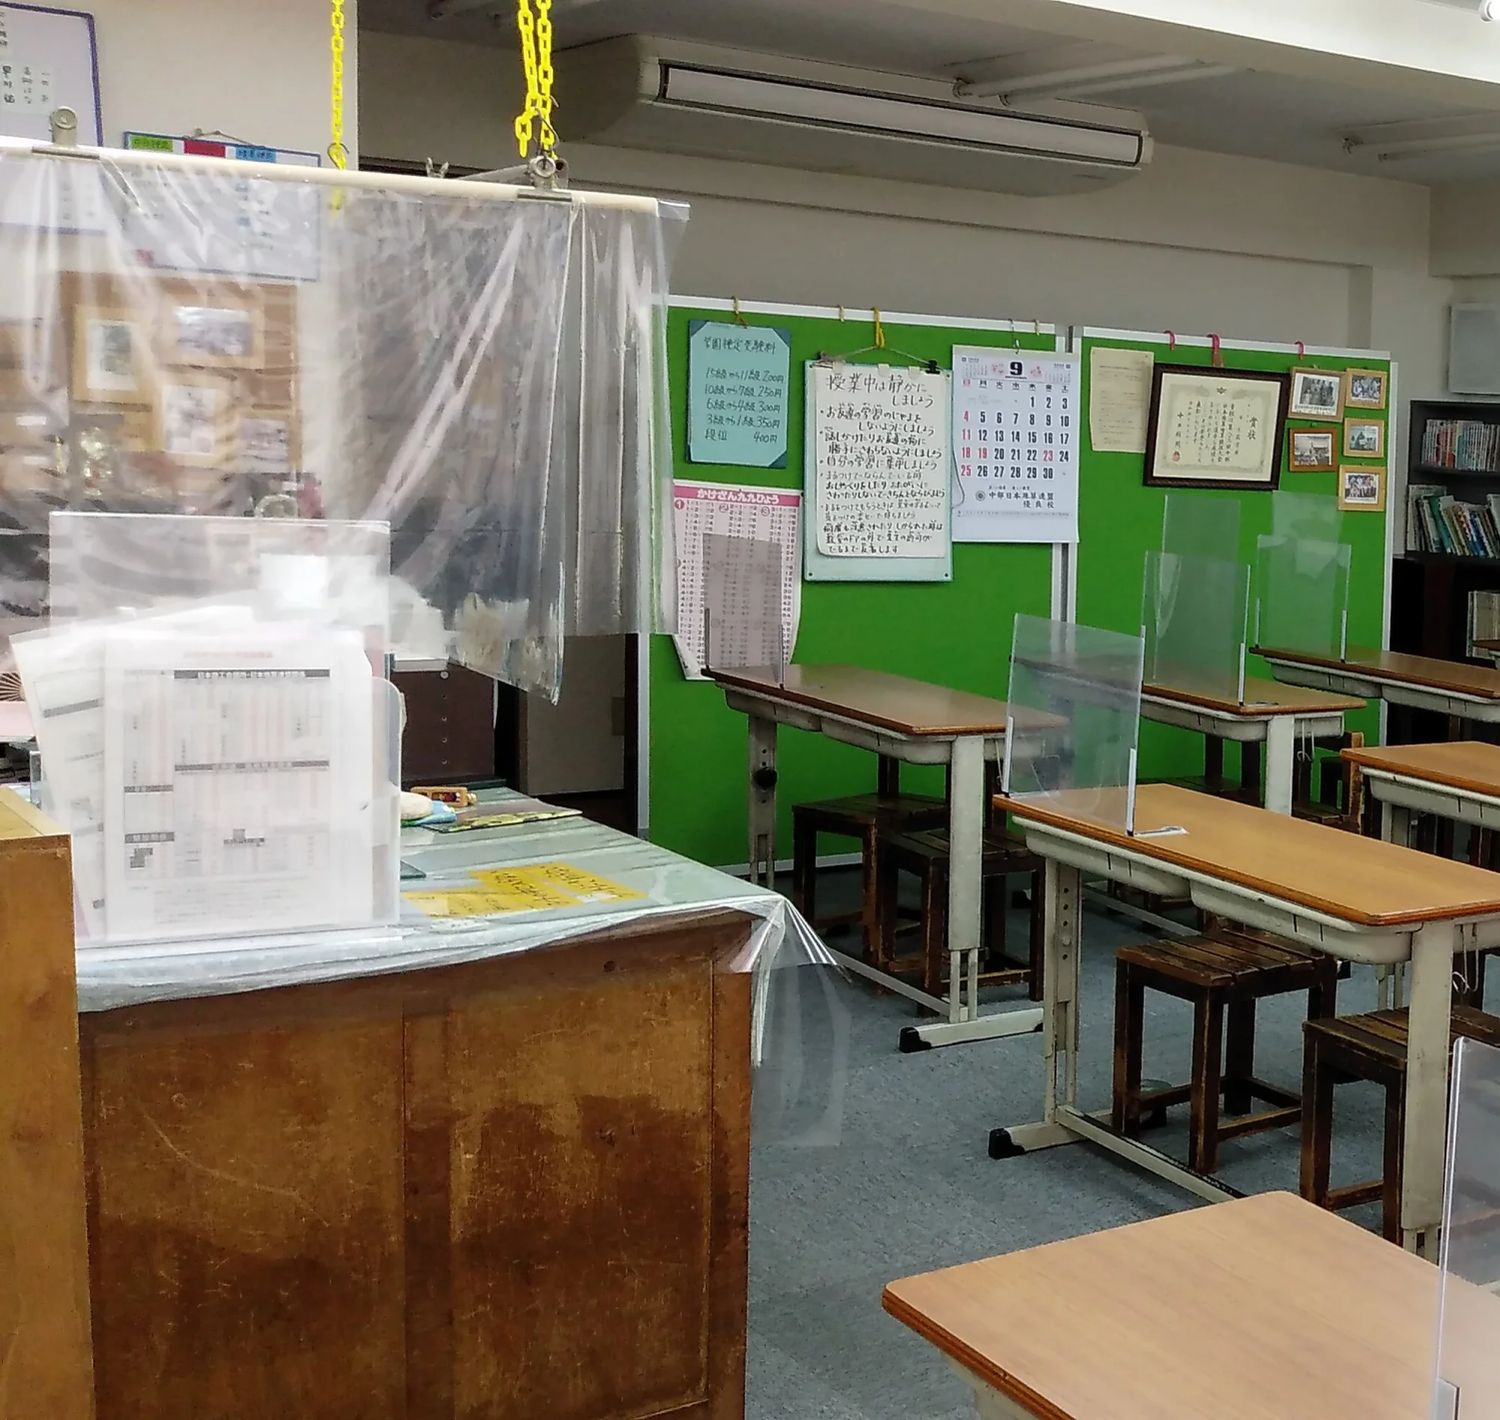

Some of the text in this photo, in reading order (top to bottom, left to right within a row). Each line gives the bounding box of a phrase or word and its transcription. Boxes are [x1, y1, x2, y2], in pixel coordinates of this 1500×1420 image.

[1009, 362, 1023, 376] 9
[892, 395, 934, 409] しましょう
[1046, 397, 1051, 409] 2
[1062, 398, 1068, 410] 3
[964, 411, 1069, 427] 4 5 6 7 8 9 10
[962, 430, 1069, 444] 11 12 13 14 15 16 17
[962, 447, 1069, 462] 18 19 20 21 22 23 24
[961, 465, 1053, 479] 25 26 27 28 29 30
[696, 488, 780, 504] かけざん九九ひょう
